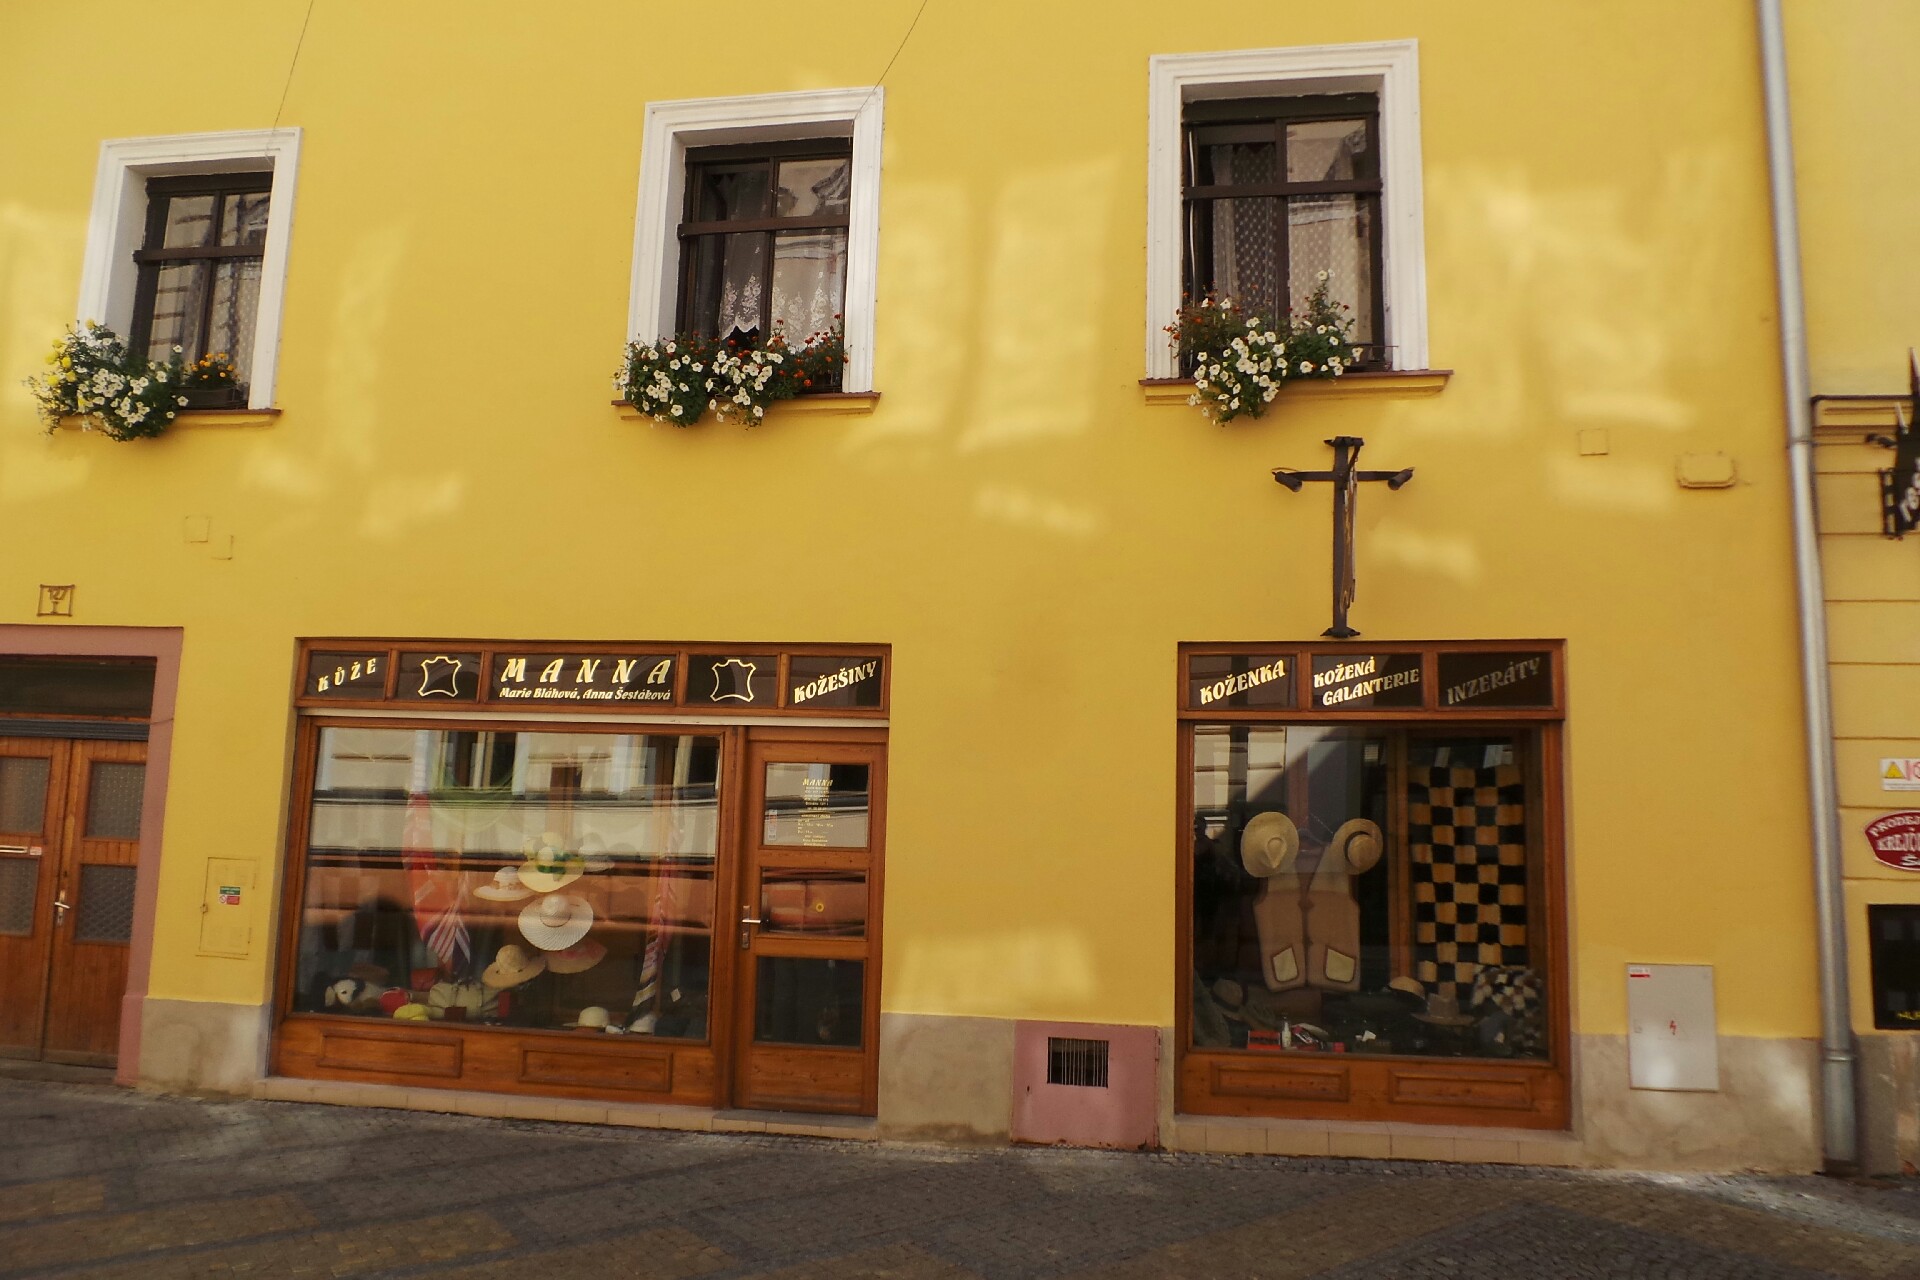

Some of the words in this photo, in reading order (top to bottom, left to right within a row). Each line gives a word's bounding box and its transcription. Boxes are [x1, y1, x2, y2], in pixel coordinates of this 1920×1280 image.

[317, 657, 376, 692] KŮŽE
[500, 658, 671, 684] MANNA
[793, 660, 877, 704] KOŽEŠINY
[1199, 659, 1286, 705] KOŽENKA
[1313, 656, 1375, 689] KOŽENÁ
[1322, 668, 1419, 706] GALANTERIE
[1447, 657, 1540, 705] INZERÁTY
[499, 687, 532, 698] Marie
[533, 687, 581, 700] Bláhová,
[583, 688, 613, 699] Anna
[614, 686, 671, 700] Šestáková
